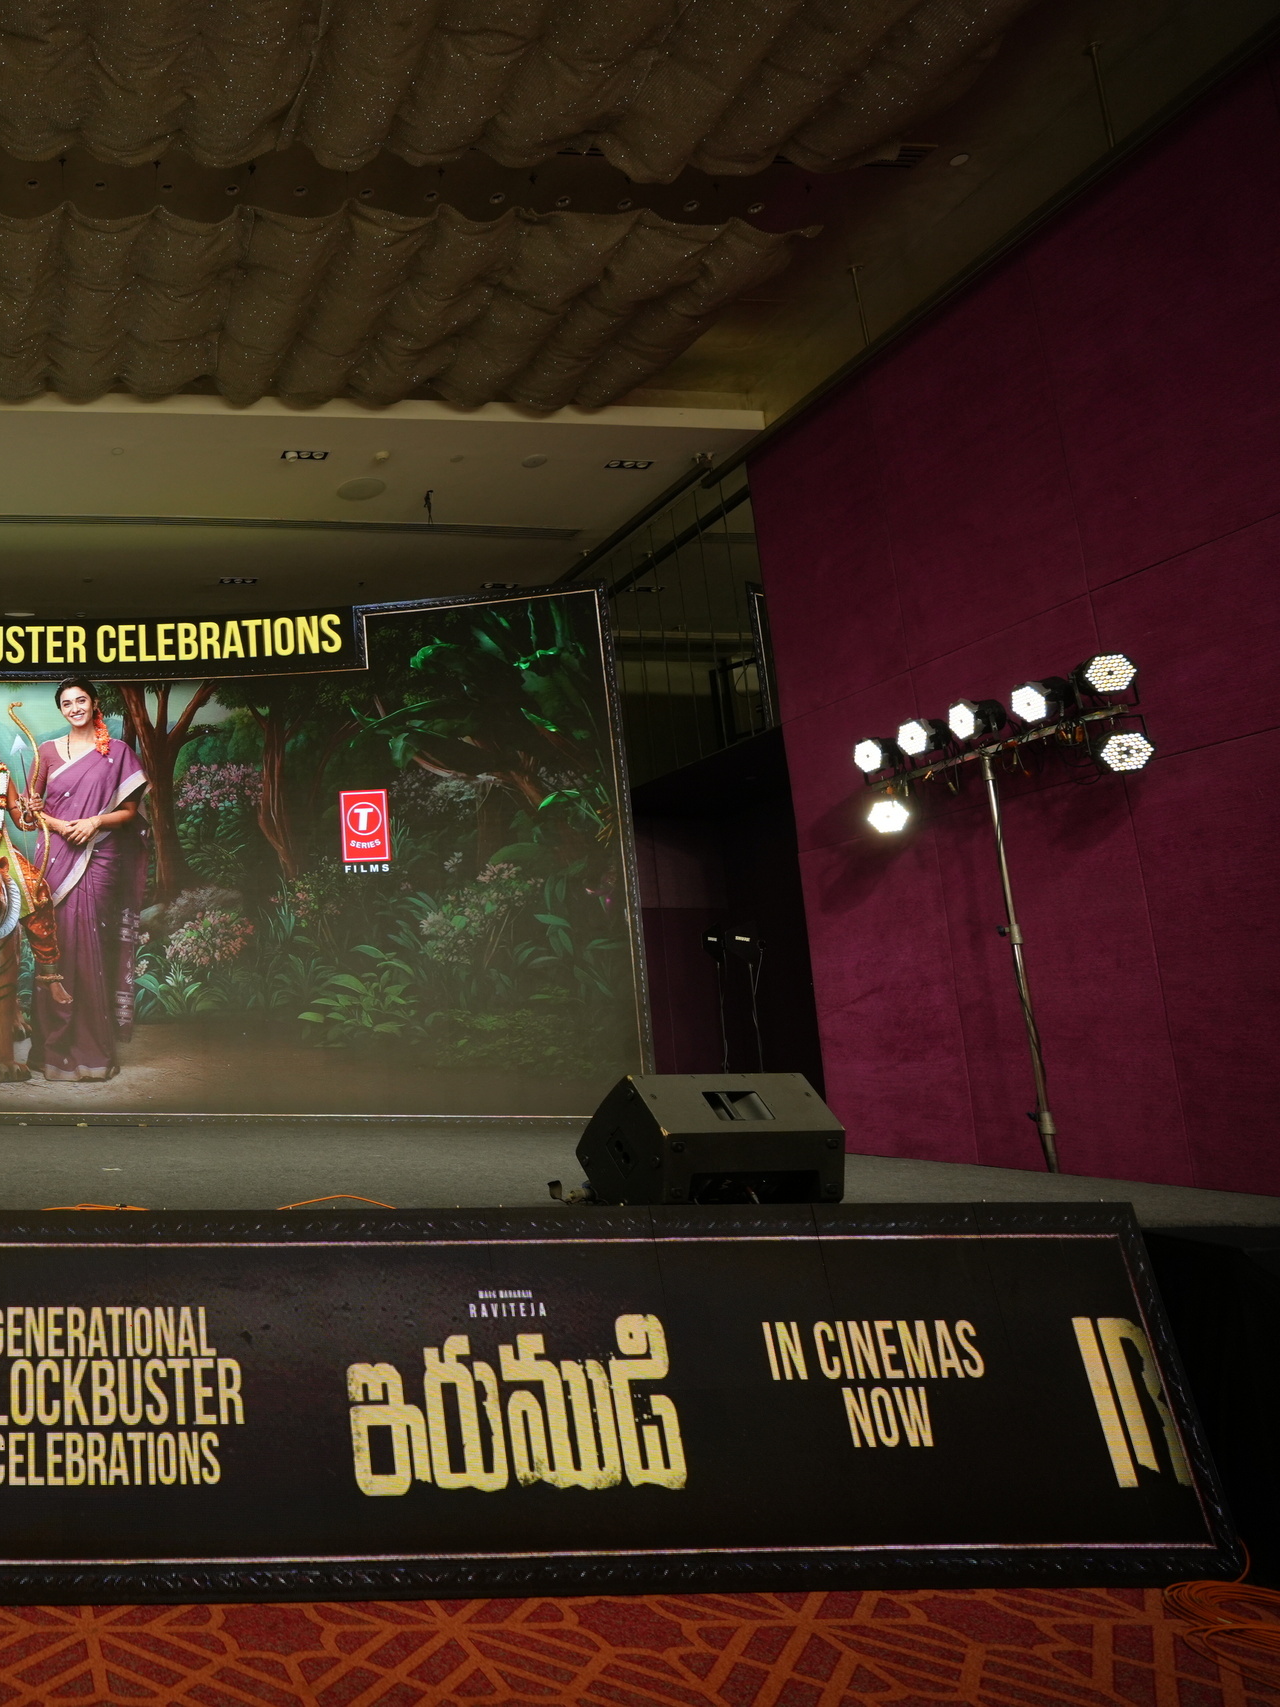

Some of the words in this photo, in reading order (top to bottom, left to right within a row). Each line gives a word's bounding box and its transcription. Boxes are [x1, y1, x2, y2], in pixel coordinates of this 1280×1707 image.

[96, 613, 342, 664] CELEBRATIONS
[353, 808, 374, 831] T
[349, 839, 381, 849] SERIES
[344, 863, 390, 873] FILMS
[468, 1302, 547, 1318] RAVITEJA
[761, 1321, 809, 1380] IN
[813, 1319, 986, 1380] CINEMAS
[841, 1386, 935, 1448] NOW
